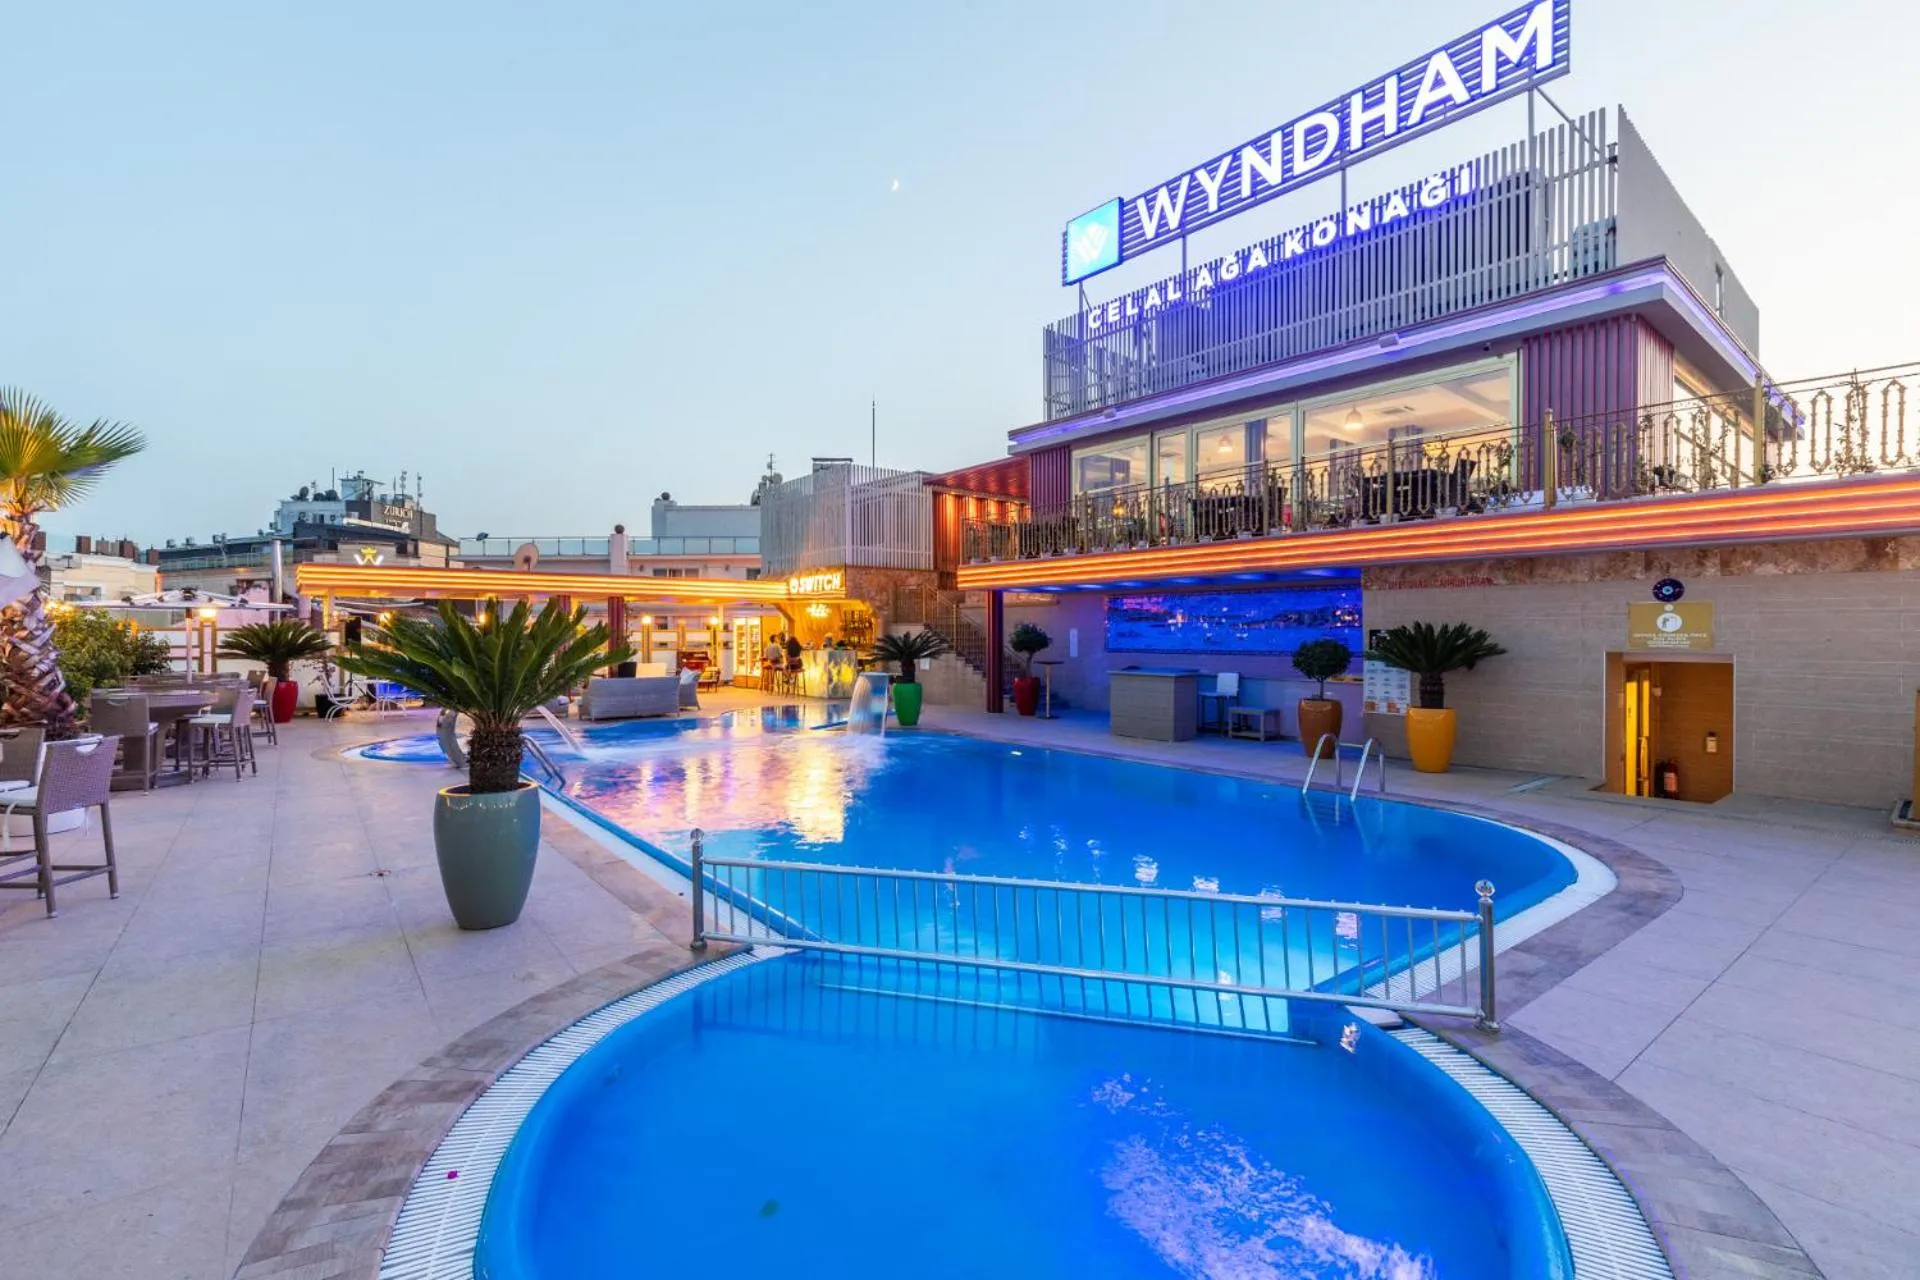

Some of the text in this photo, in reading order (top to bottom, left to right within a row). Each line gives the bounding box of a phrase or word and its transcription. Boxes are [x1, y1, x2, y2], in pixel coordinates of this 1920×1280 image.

[1136, 0, 1554, 241] WYNDHAM
[1088, 281, 1182, 329] CELAL
[1284, 167, 1472, 259] KONAĞI
